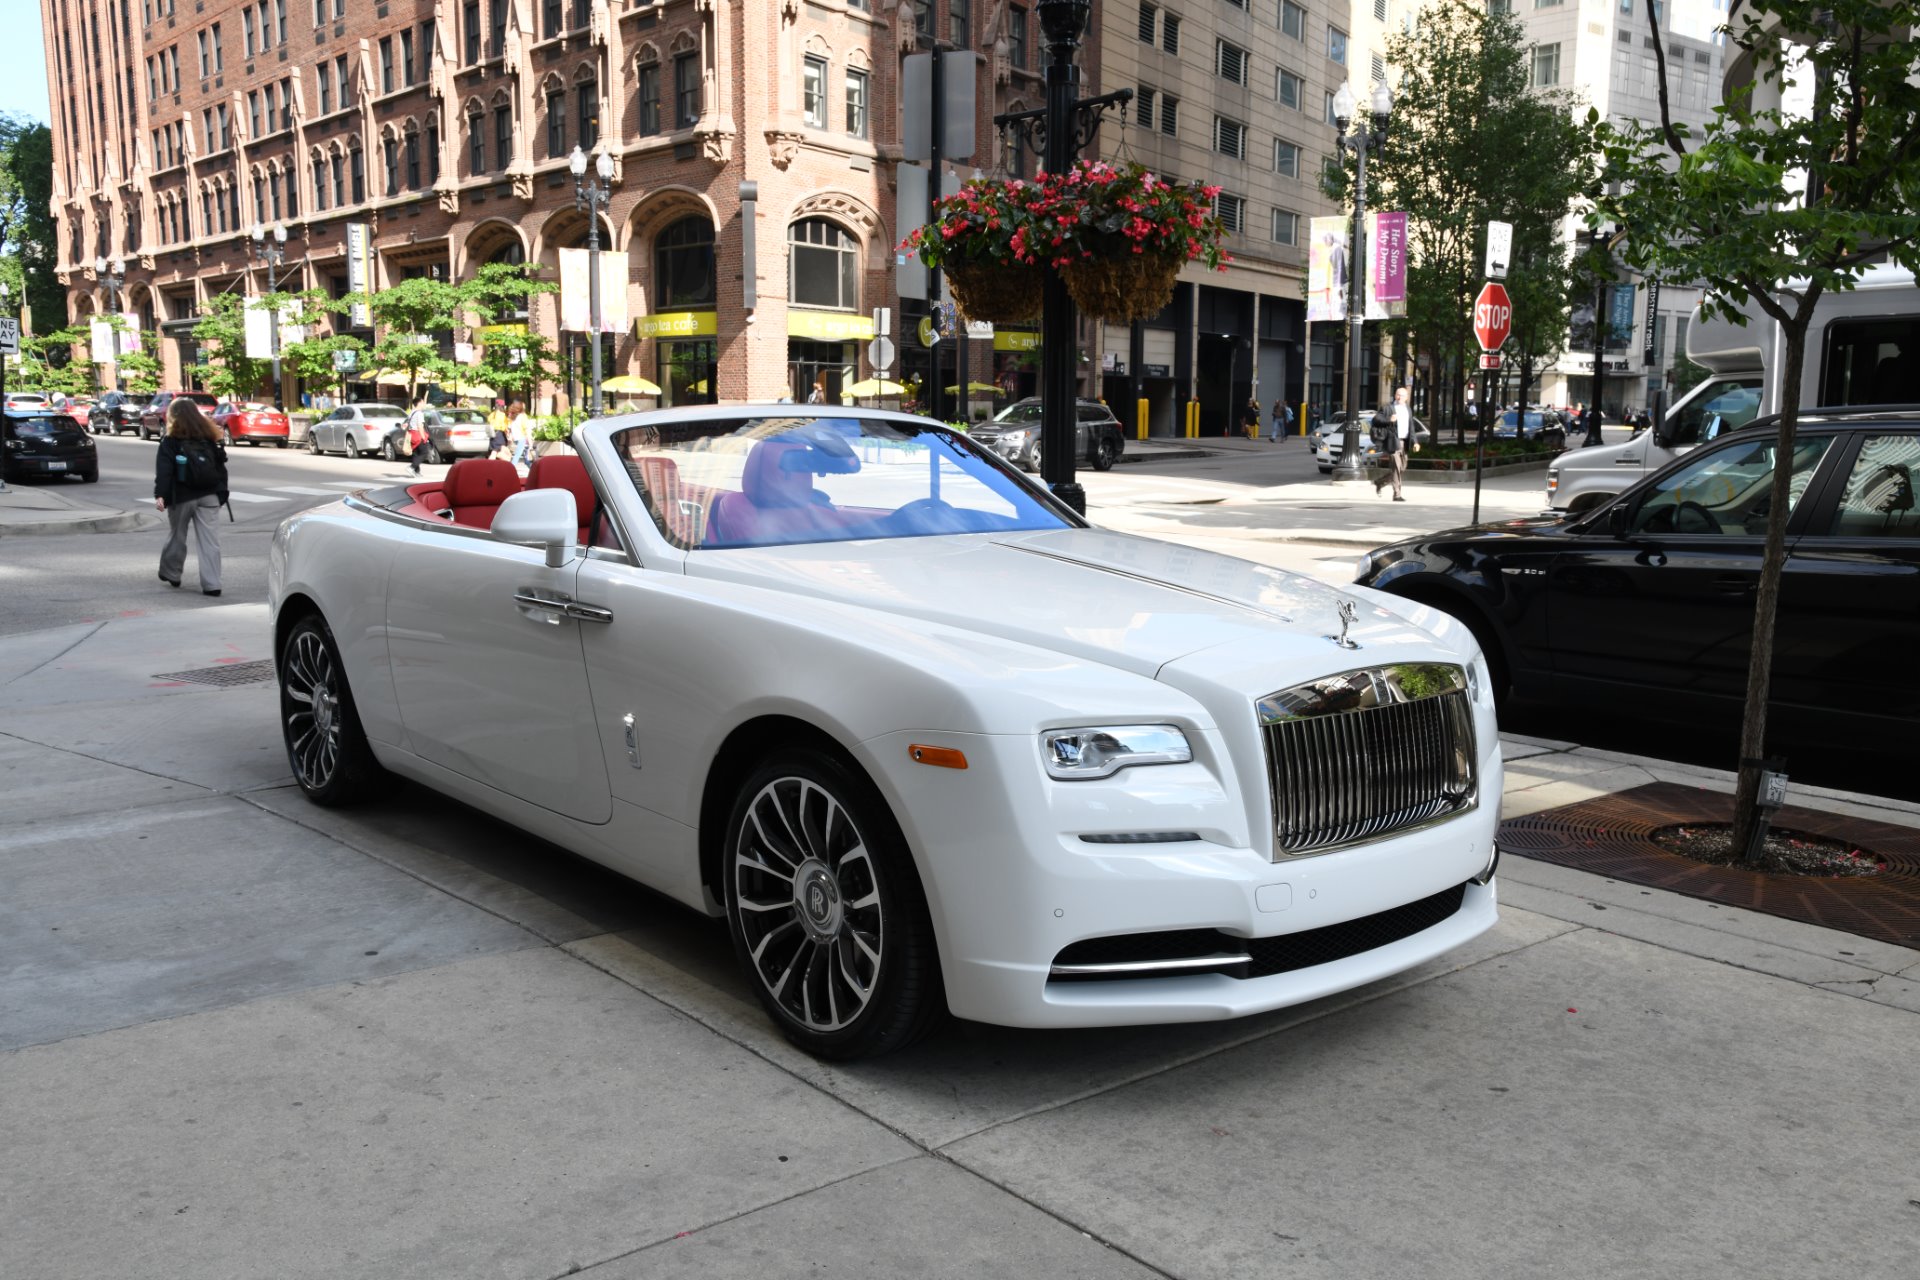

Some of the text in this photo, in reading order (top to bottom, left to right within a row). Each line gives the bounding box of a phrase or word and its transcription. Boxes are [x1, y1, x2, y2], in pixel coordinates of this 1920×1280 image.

[1378, 229, 1390, 245] My
[1391, 228, 1401, 247] Her
[1379, 248, 1389, 285] Dreams
[0, 320, 15, 330] NE
[1477, 303, 1509, 330] STOP
[1644, 281, 1657, 351] ORDSTROM rack
[0, 330, 15, 340] AY
